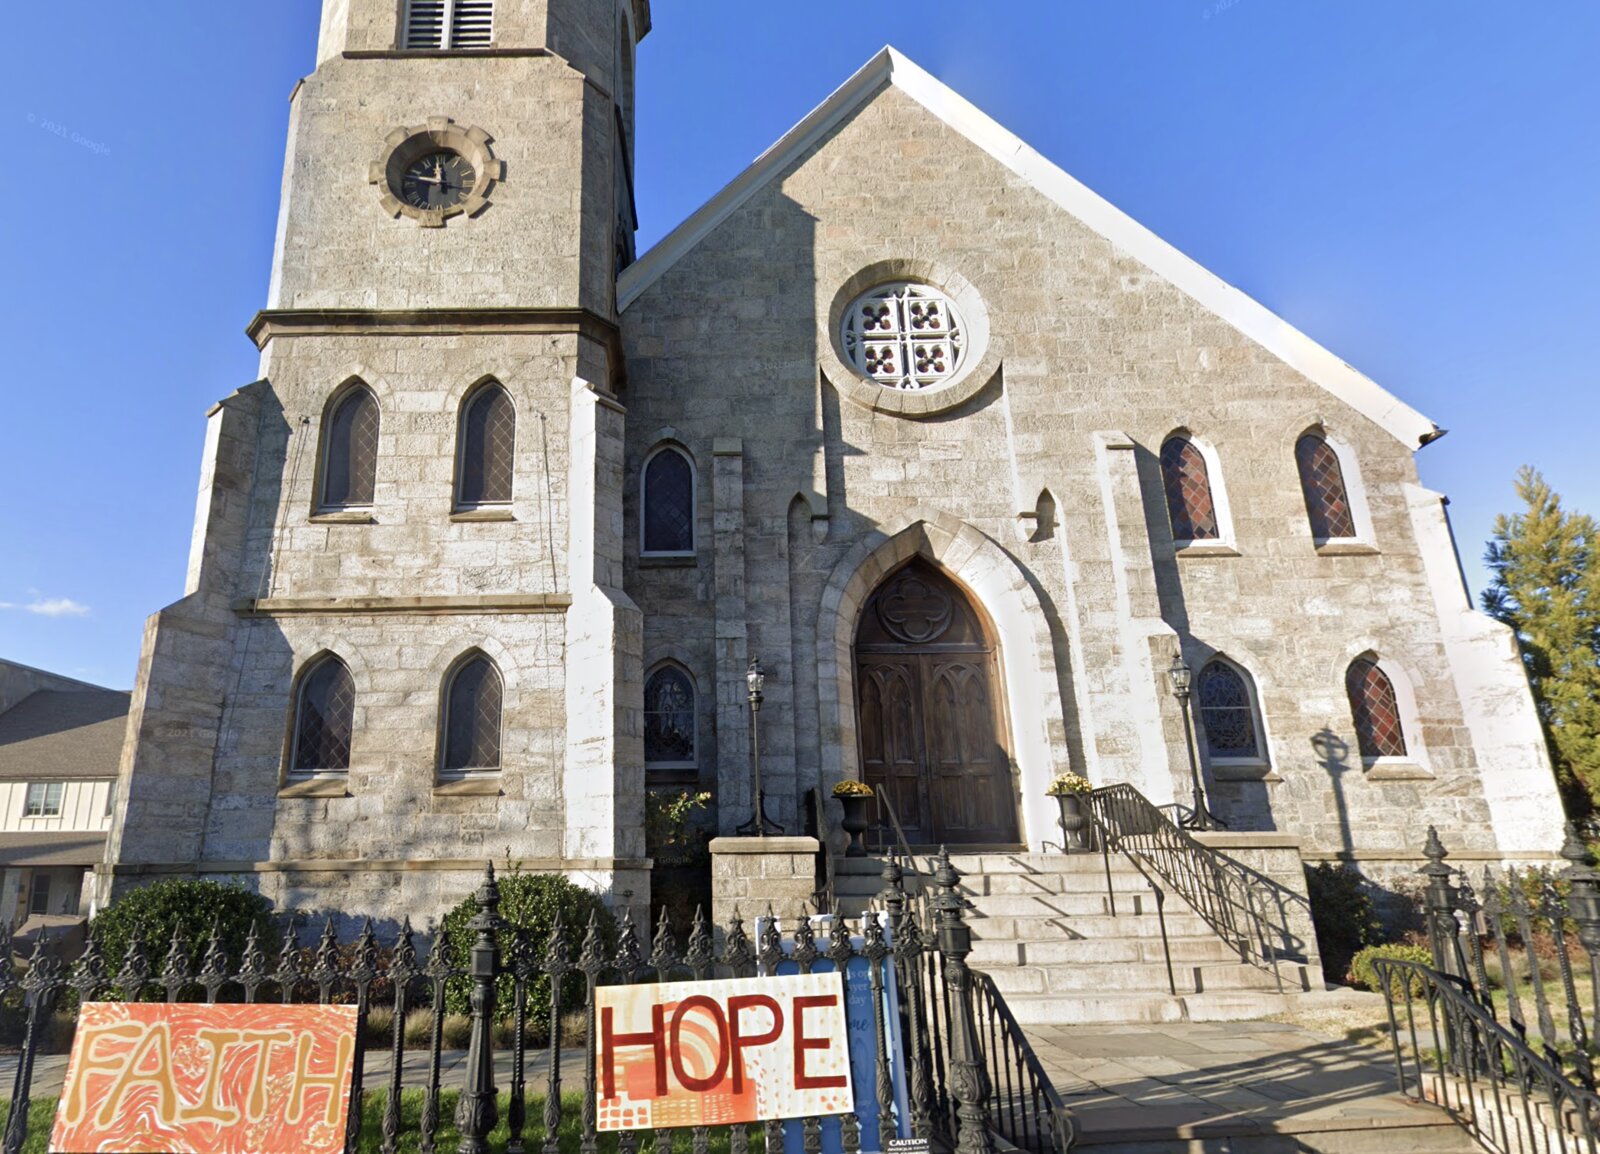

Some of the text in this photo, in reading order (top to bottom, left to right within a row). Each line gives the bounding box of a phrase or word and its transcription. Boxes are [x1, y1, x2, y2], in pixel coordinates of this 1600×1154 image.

[62, 1020, 354, 1132] FAITH
[601, 994, 847, 1100] HOPE
[888, 1138, 928, 1147] CAUTION
